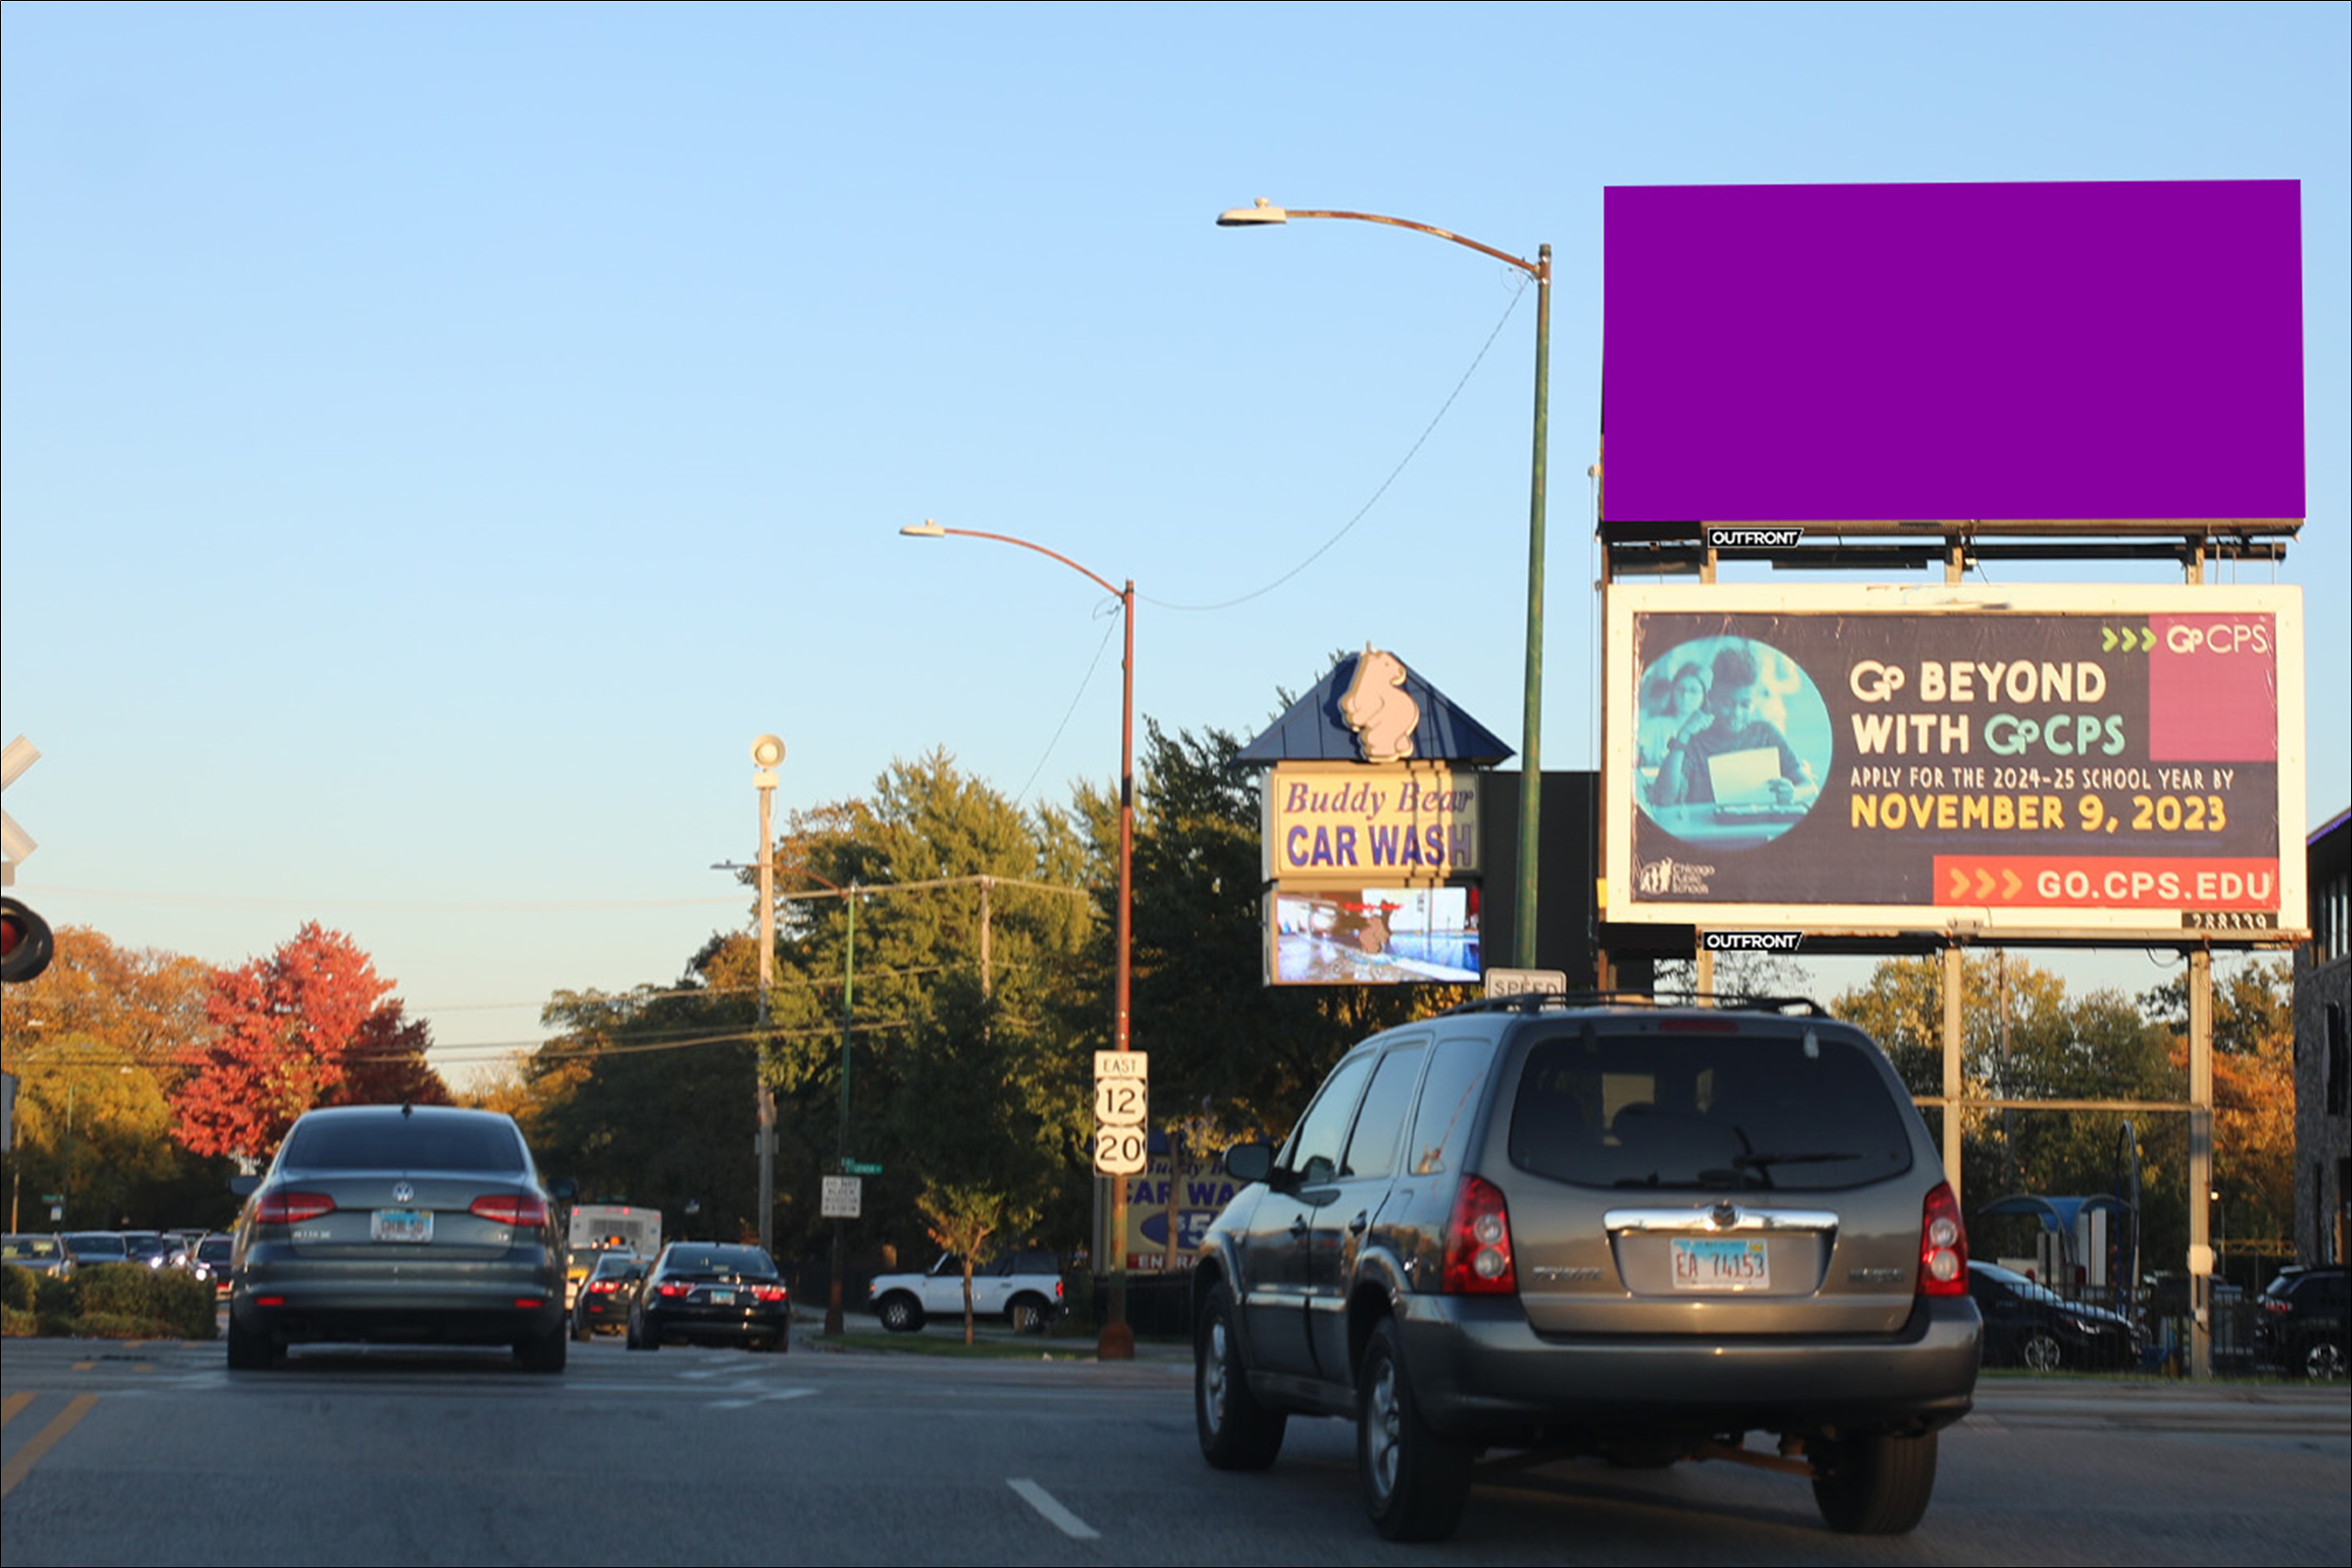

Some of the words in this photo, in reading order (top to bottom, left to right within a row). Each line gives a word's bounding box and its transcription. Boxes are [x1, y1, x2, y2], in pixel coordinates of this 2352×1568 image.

[1712, 531, 1797, 545] OUTFRONT
[1920, 661, 2106, 703] BEYOND
[1851, 713, 1970, 755] WITH
[1850, 767, 1901, 788] APPLY
[1910, 767, 1944, 788] FOR
[1952, 767, 1984, 788] THE
[1993, 767, 2075, 789] 2024-25
[2082, 768, 2150, 790] SCHOOL
[2158, 768, 2203, 790] YEAR
[2213, 769, 2233, 790] BY
[1284, 781, 1386, 820] Buddy
[1396, 780, 1474, 812] Bear
[1850, 794, 2065, 830] NOVEMBER
[2079, 795, 2119, 834] 9,
[2131, 796, 2227, 832] 2023
[1287, 824, 1358, 866] CAR
[1368, 824, 1471, 866] WASH
[2036, 871, 2270, 902] GO.CPS.EDU
[1706, 935, 1797, 948] OUTFRONT
[1103, 1058, 1136, 1073] EAST
[1106, 1088, 1136, 1113] 12
[1101, 1135, 1141, 1161] 20
[1677, 1253, 1697, 1278] EA
[1710, 1253, 1764, 1278] 74153
